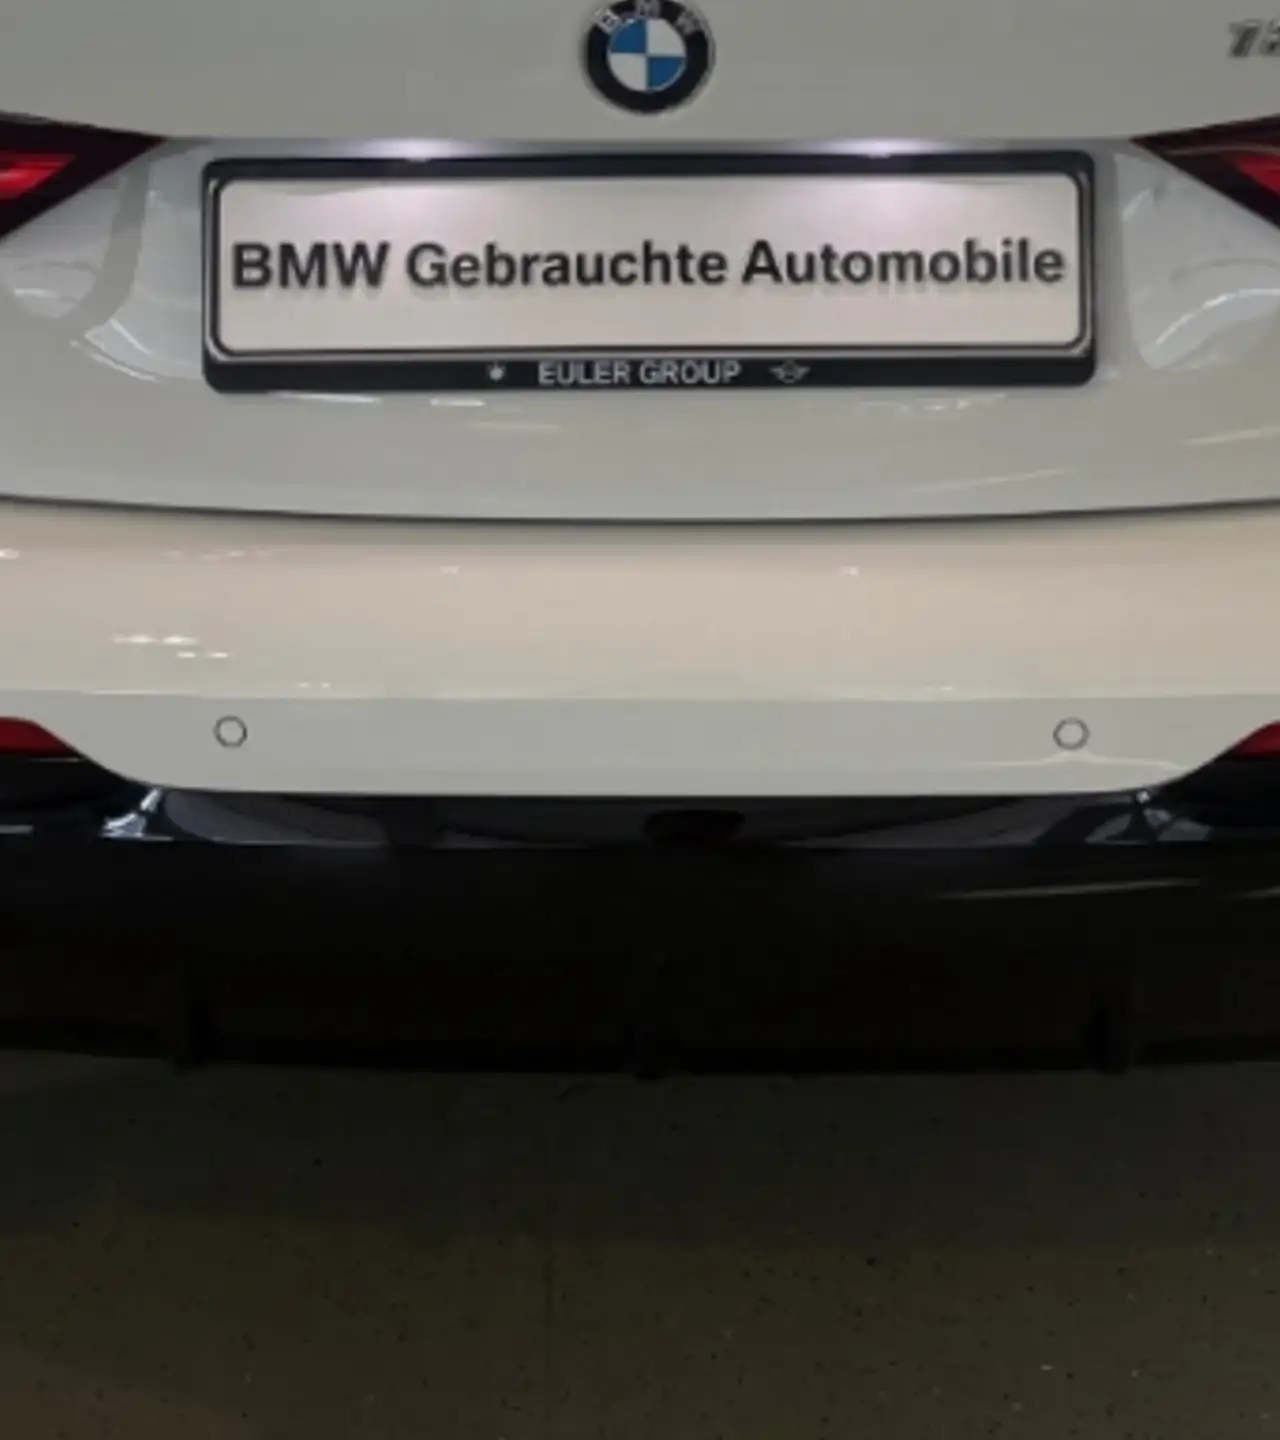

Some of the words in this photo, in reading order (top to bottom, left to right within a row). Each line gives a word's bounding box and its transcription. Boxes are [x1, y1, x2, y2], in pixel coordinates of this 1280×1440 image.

[232, 241, 391, 289] BMW
[405, 239, 728, 289] Gebrauchte
[741, 236, 1067, 286] Automobile
[537, 360, 631, 385] EULER
[638, 360, 742, 385] GROUP
